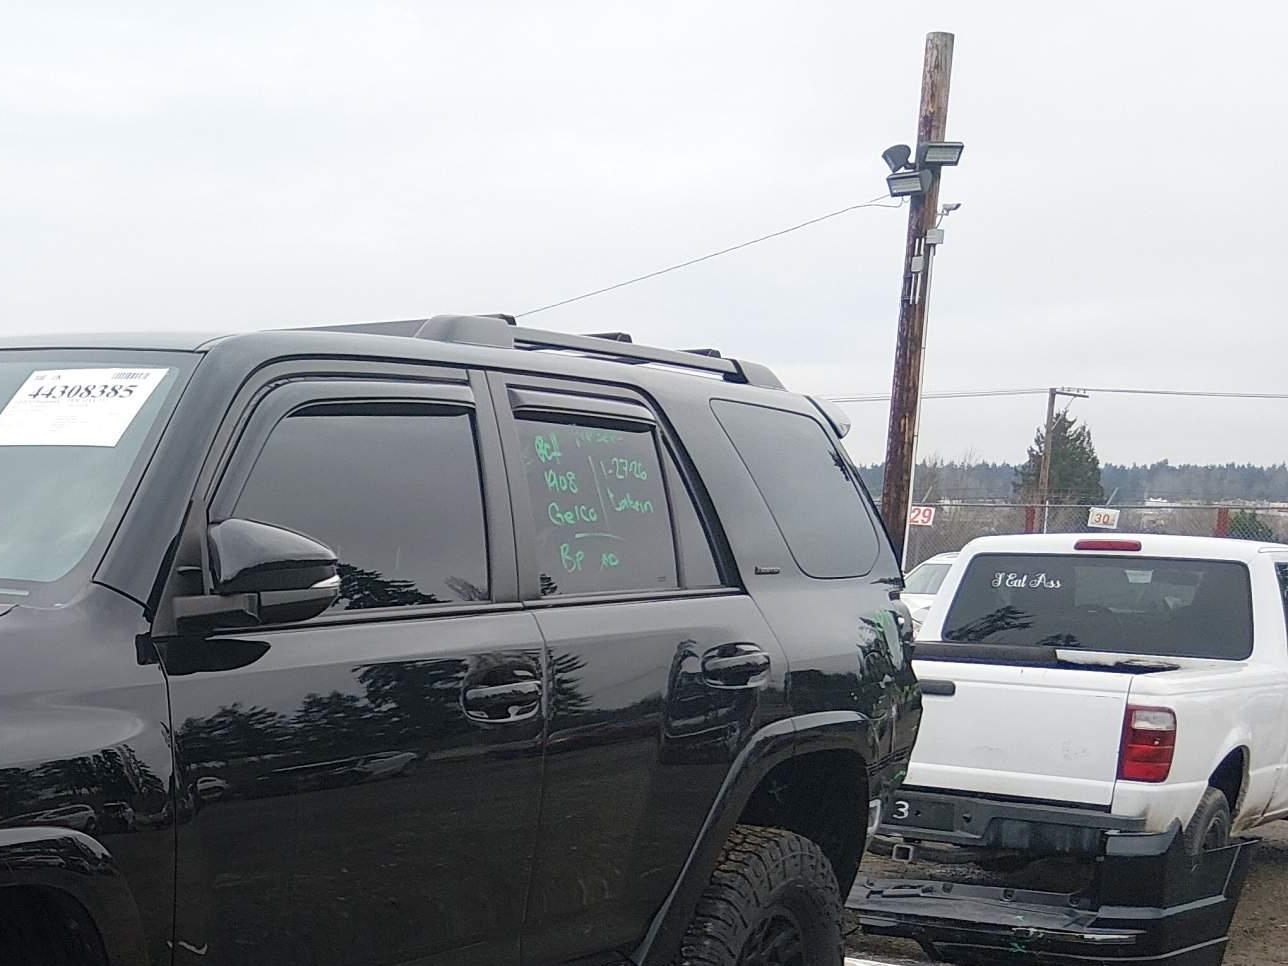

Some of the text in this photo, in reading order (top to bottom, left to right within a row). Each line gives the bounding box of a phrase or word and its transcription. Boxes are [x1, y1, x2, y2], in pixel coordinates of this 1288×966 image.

[28, 384, 138, 399] 44308385
[909, 507, 933, 524] 29
[1005, 572, 1028, 588] Eat
[1029, 572, 1061, 588] Ass
[892, 800, 910, 819] 3
